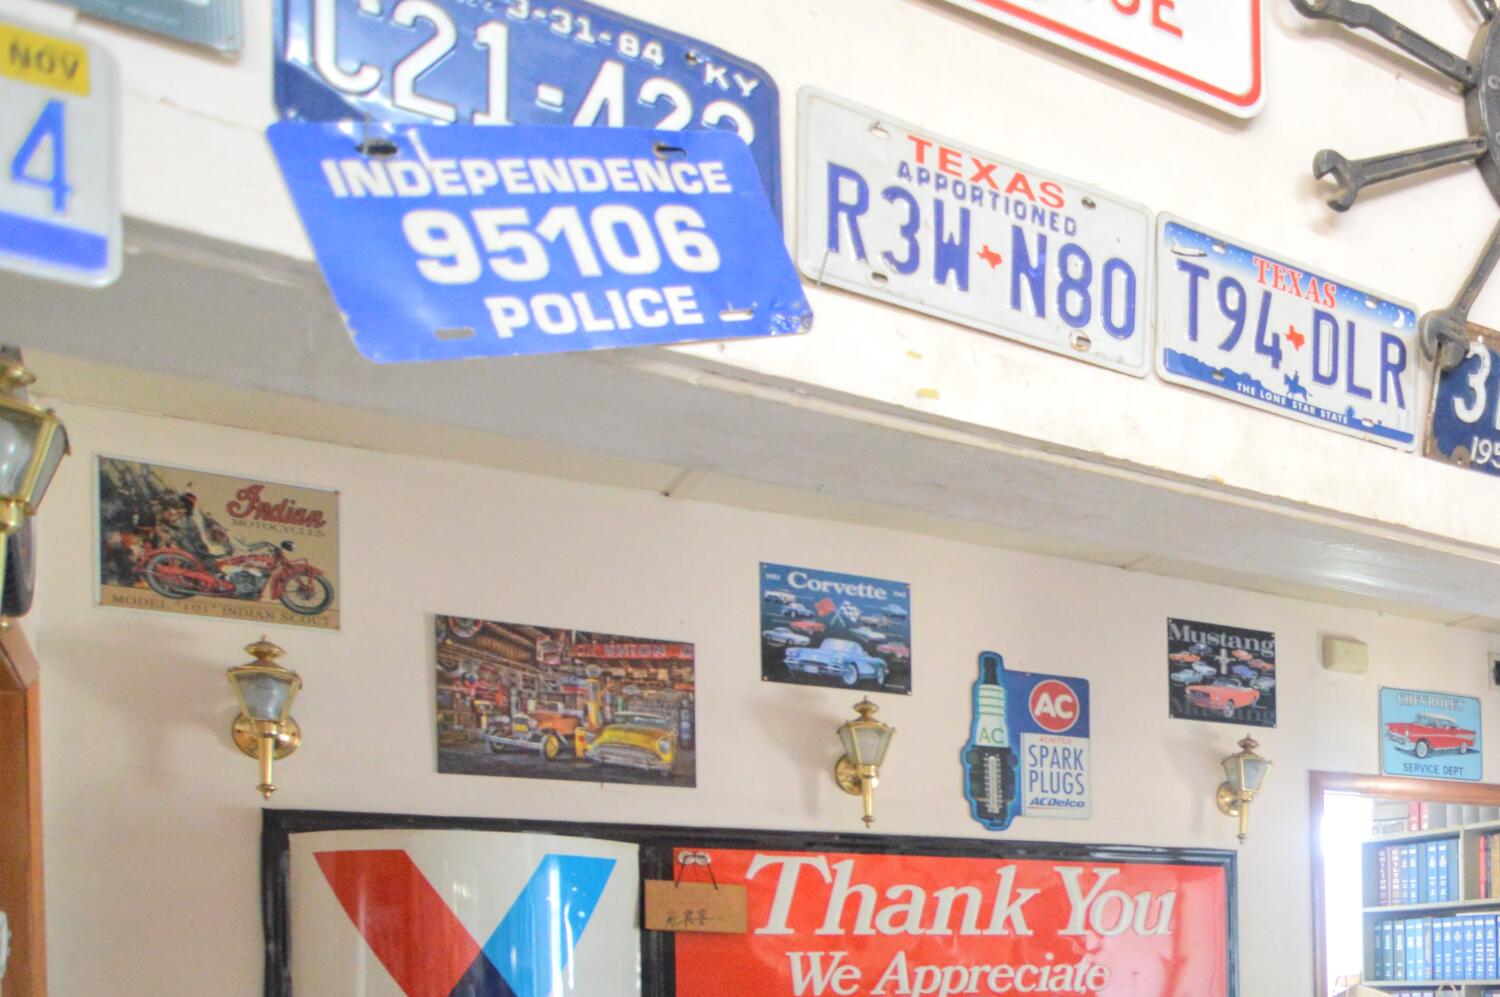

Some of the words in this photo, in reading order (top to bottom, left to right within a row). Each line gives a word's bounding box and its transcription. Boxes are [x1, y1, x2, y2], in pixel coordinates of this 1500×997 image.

[9, 43, 80, 77] NOV
[704, 64, 760, 98] KY
[11, 99, 72, 214] 4
[906, 133, 1067, 210] TEXAS
[323, 157, 732, 200] INDEPENDENCE
[897, 162, 1078, 237] APPORTIONED
[402, 204, 721, 285] 95106
[825, 162, 971, 293] R3W
[1008, 224, 1139, 340] N80
[1251, 256, 1337, 309] TEXAS
[486, 285, 704, 339] POLICE
[1176, 257, 1282, 370] T94
[1311, 309, 1407, 411] DLR
[1236, 382, 1256, 396] THE
[1258, 387, 1288, 406] LONE
[1290, 398, 1317, 416] STAR
[1320, 408, 1349, 426] STATE
[226, 483, 327, 529] Indian
[787, 571, 887, 600] Corvette
[112, 594, 165, 609] MODEL
[222, 606, 275, 621] INDIAN
[282, 611, 330, 626] SCOUT
[1168, 622, 1275, 657] Mustang
[1034, 692, 1073, 720] AC
[979, 726, 1004, 744] AC
[1028, 745, 1084, 771] SPARK
[1402, 762, 1439, 775] SERVICE
[1029, 770, 1085, 796] PLUGS
[1029, 797, 1085, 809] ACDelco
[1392, 849, 1400, 890] CHILTON
[746, 853, 1041, 936] Thank
[1053, 866, 1177, 936] You
[787, 952, 860, 997] We
